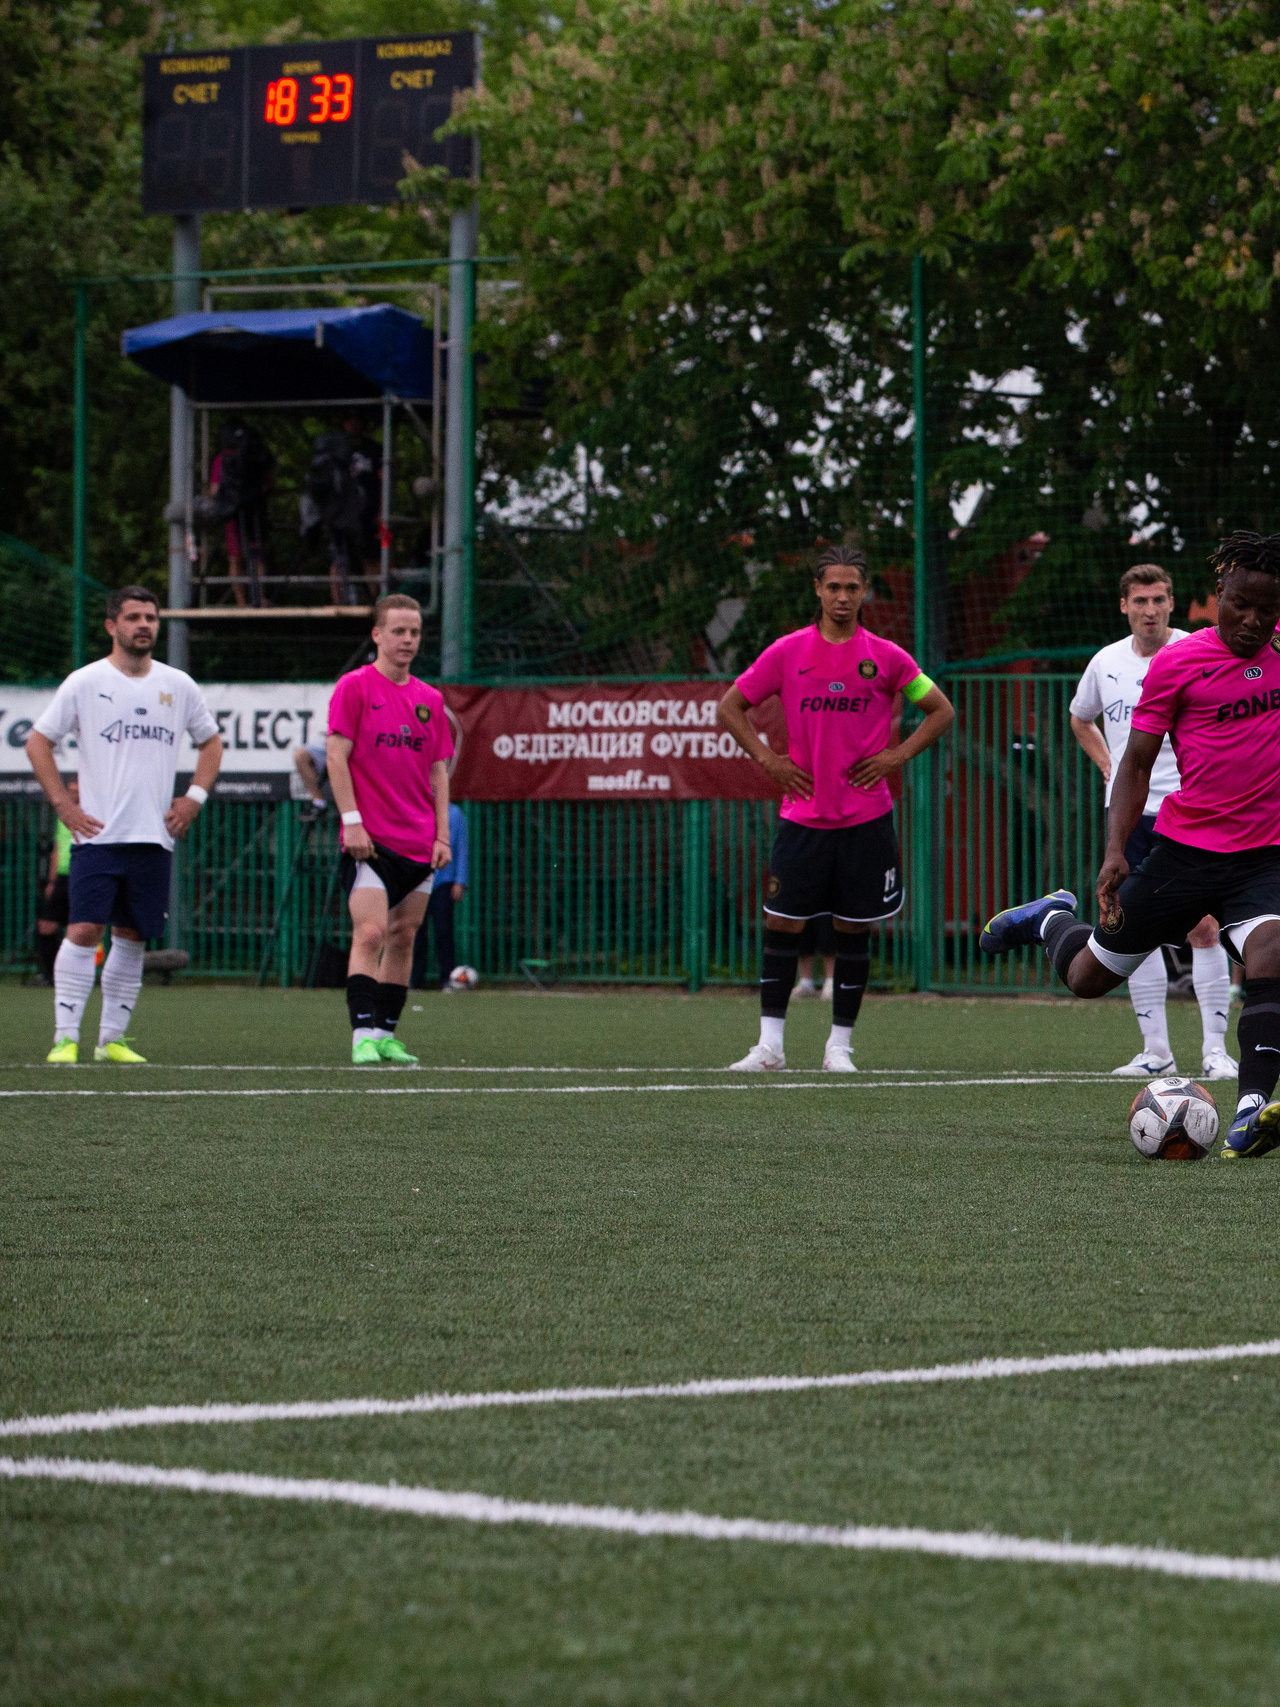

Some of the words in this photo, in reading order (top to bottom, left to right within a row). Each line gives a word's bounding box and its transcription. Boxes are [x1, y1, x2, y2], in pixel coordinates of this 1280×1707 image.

[390, 69, 436, 90] СЧЕТ
[173, 82, 220, 105] СЧЕТ
[265, 78, 299, 125] 18
[309, 73, 353, 123] 33
[547, 700, 718, 727] МОСКОВСКАЯ
[800, 696, 871, 713] FONBET
[191, 710, 313, 749] ELECT
[493, 732, 645, 763] ФЕДЕРАЦИЯ
[651, 732, 769, 758] ФУТБО
[587, 769, 671, 791] mosff.ru
